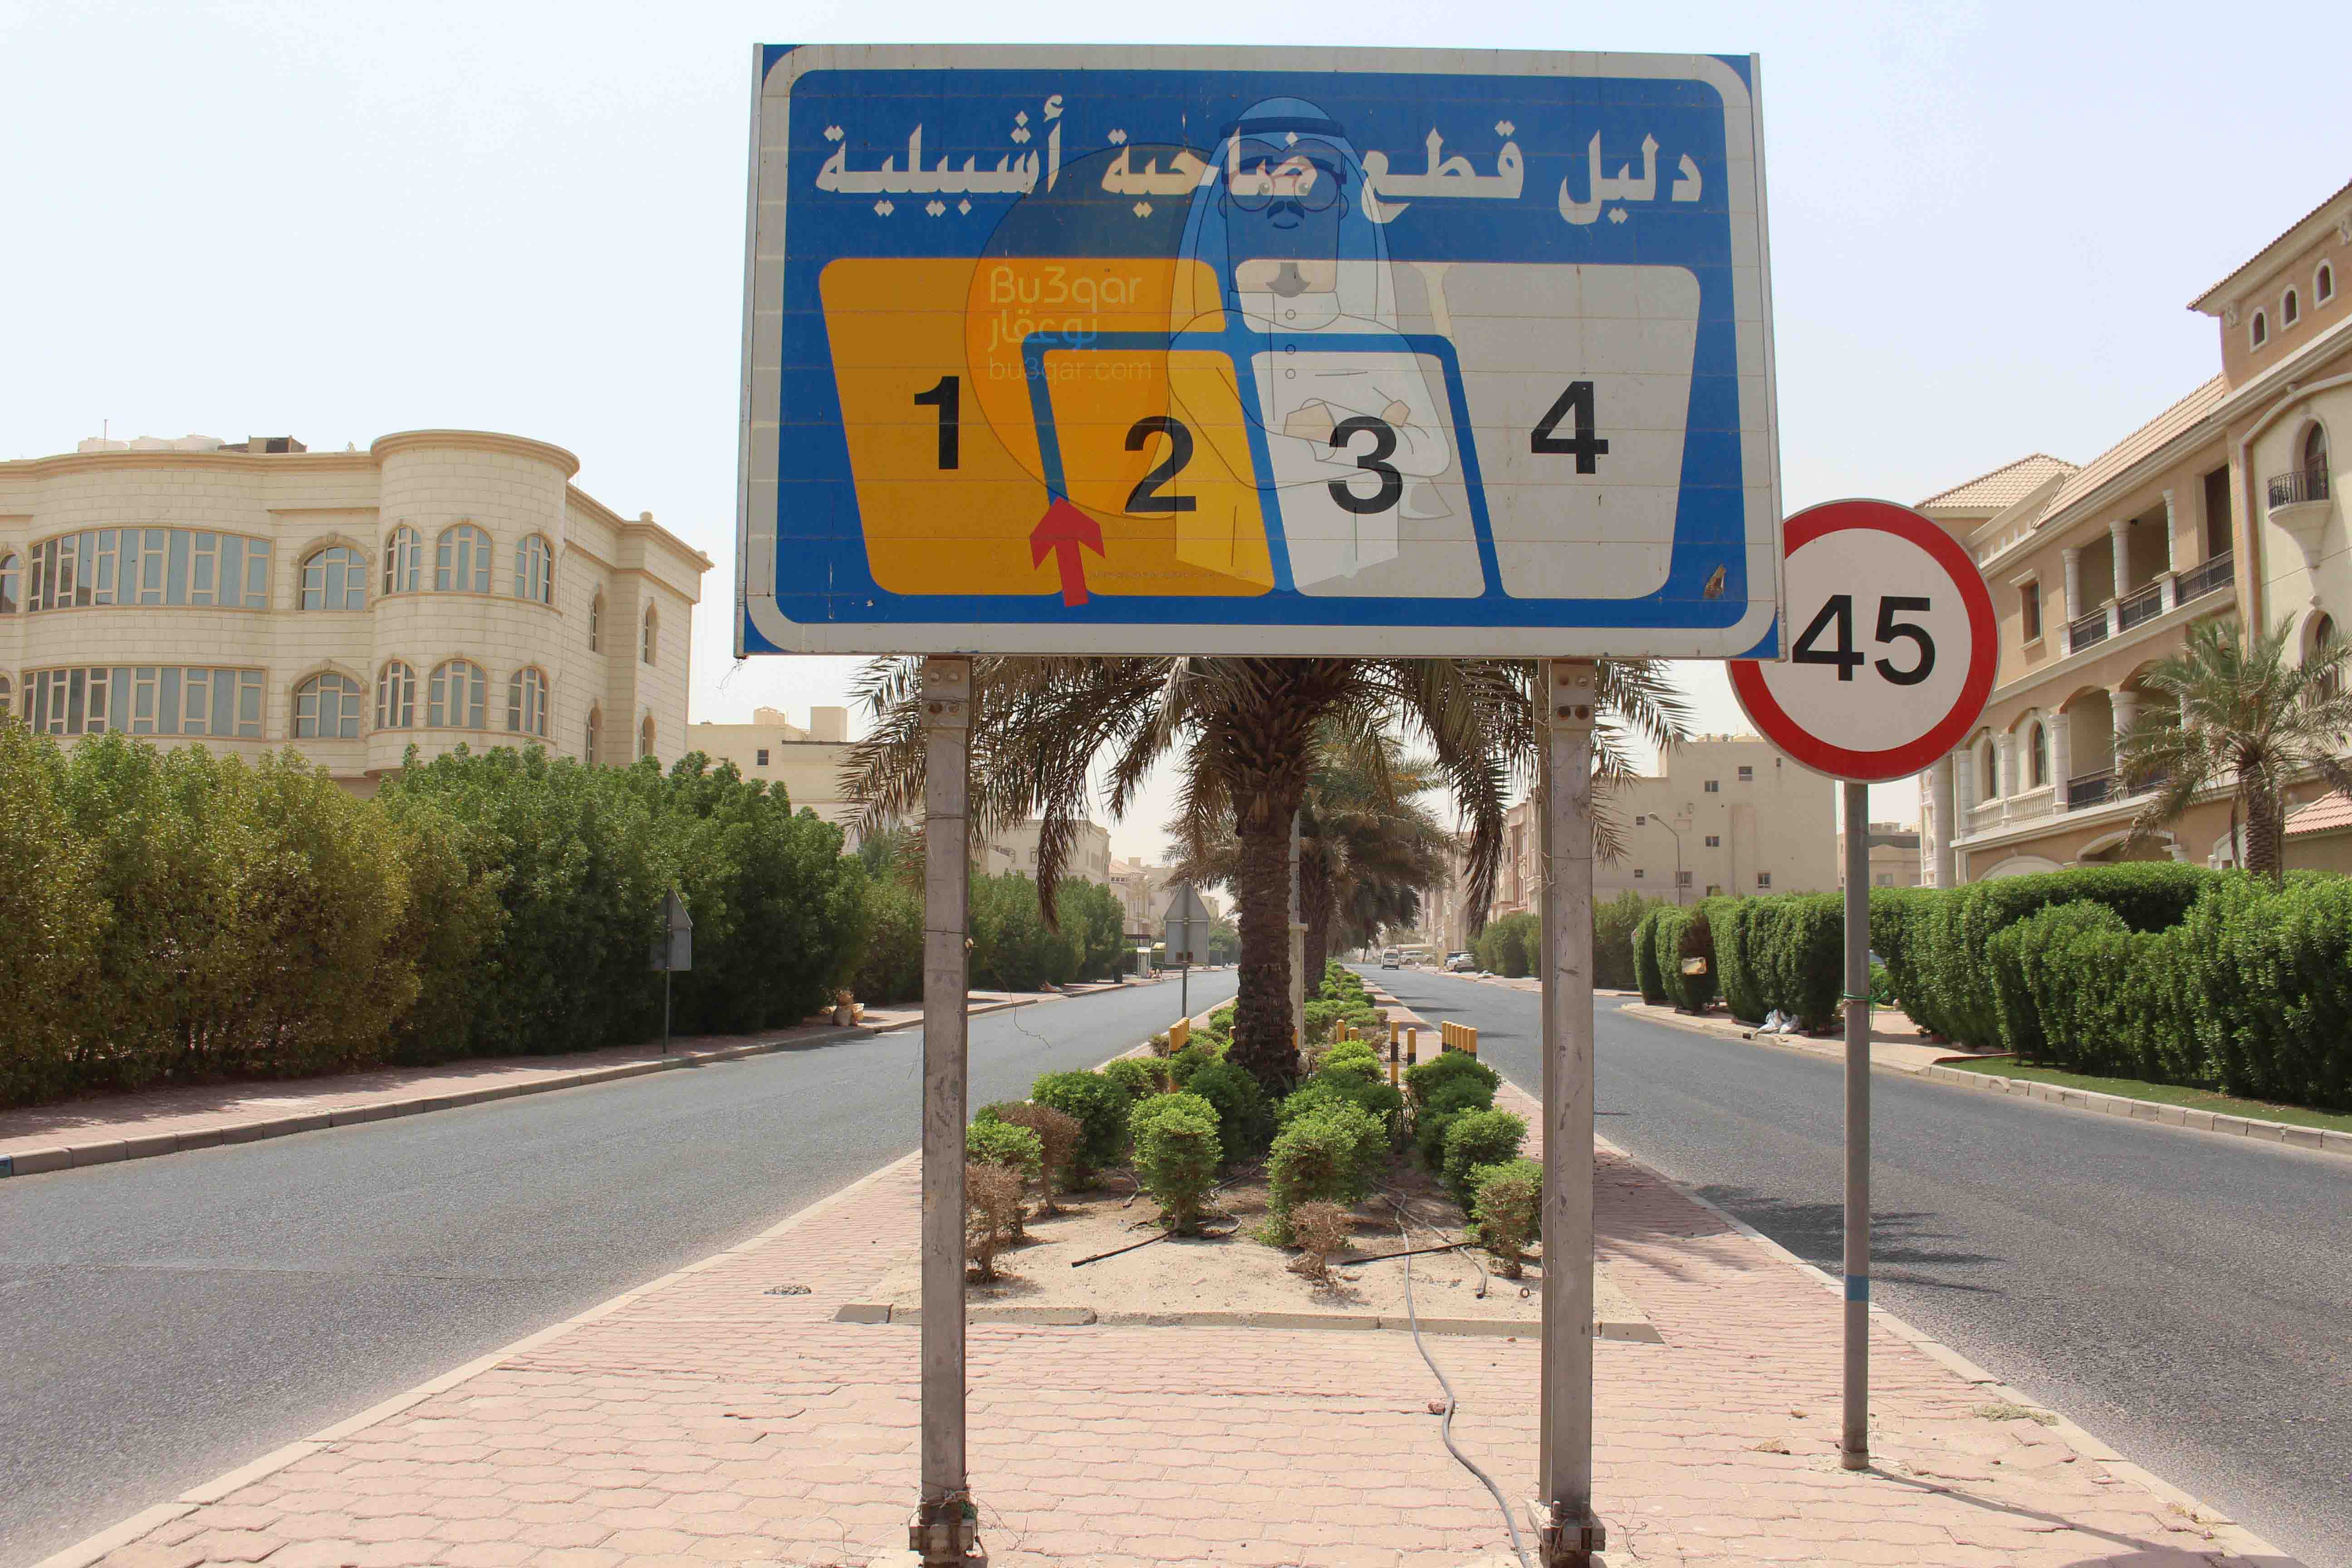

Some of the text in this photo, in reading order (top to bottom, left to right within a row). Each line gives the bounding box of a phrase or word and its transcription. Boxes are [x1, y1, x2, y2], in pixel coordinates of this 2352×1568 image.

[816, 94, 1702, 225] دليل قطع ضاحية أشبيلية
[914, 376, 959, 470] 1
[1124, 416, 1196, 512] 2
[1328, 416, 1403, 514] 3
[1531, 381, 1608, 474] 4
[1792, 595, 1935, 686] 45
